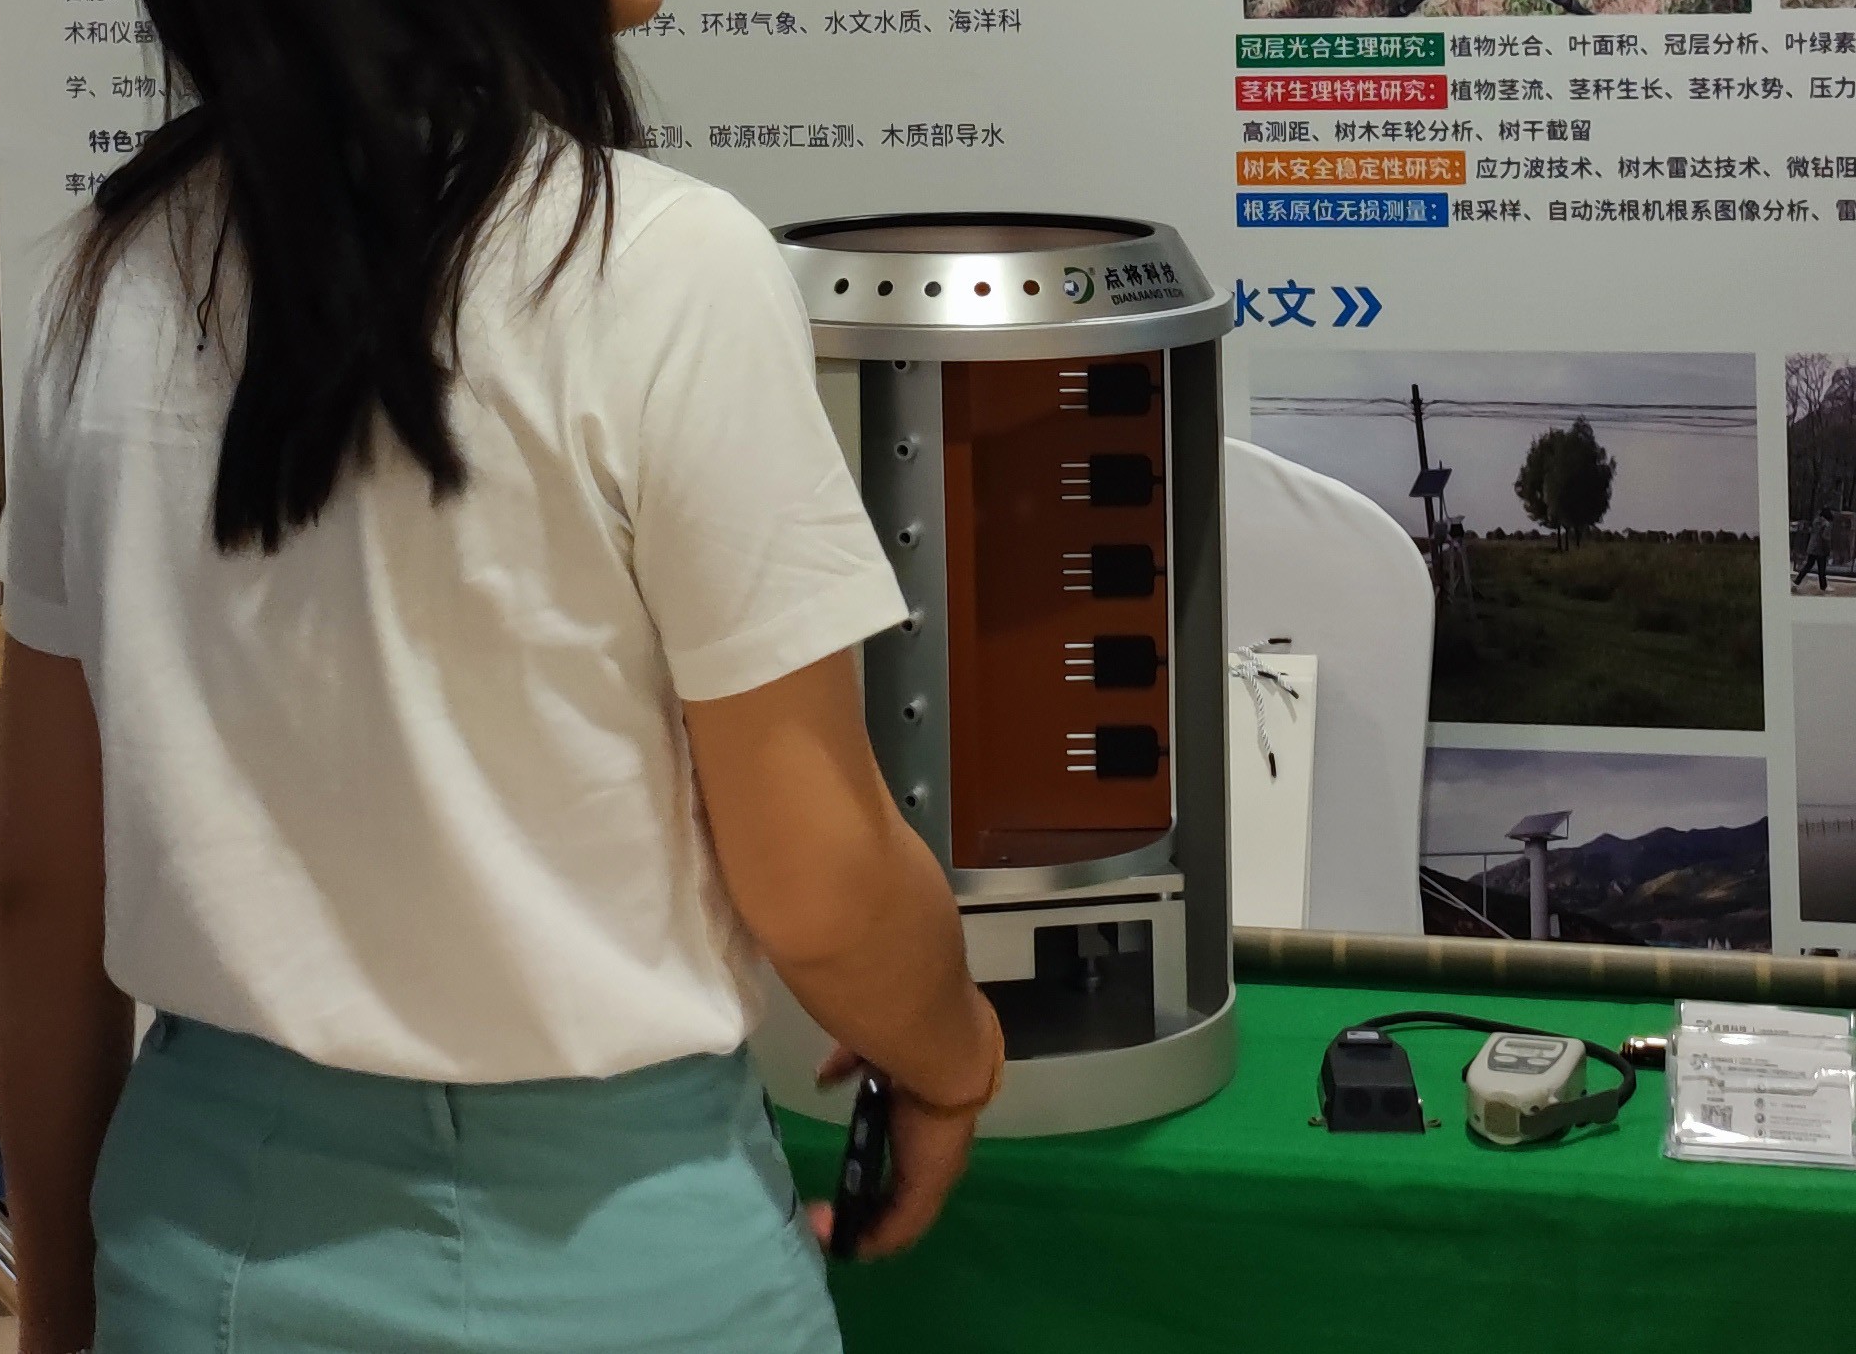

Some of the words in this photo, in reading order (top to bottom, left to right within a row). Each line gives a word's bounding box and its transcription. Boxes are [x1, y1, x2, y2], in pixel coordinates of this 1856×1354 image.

[64, 20, 155, 45] 术和仪器
[1240, 36, 1435, 59] 冠层光合生理研究：
[1242, 119, 1591, 143] 高测距、树木年轮分析、树干截留
[1243, 157, 1461, 180] 树木安全稳定性研究：
[1243, 199, 1437, 222] 根系原位无损测量：
[1104, 261, 1179, 291] 点将科技
